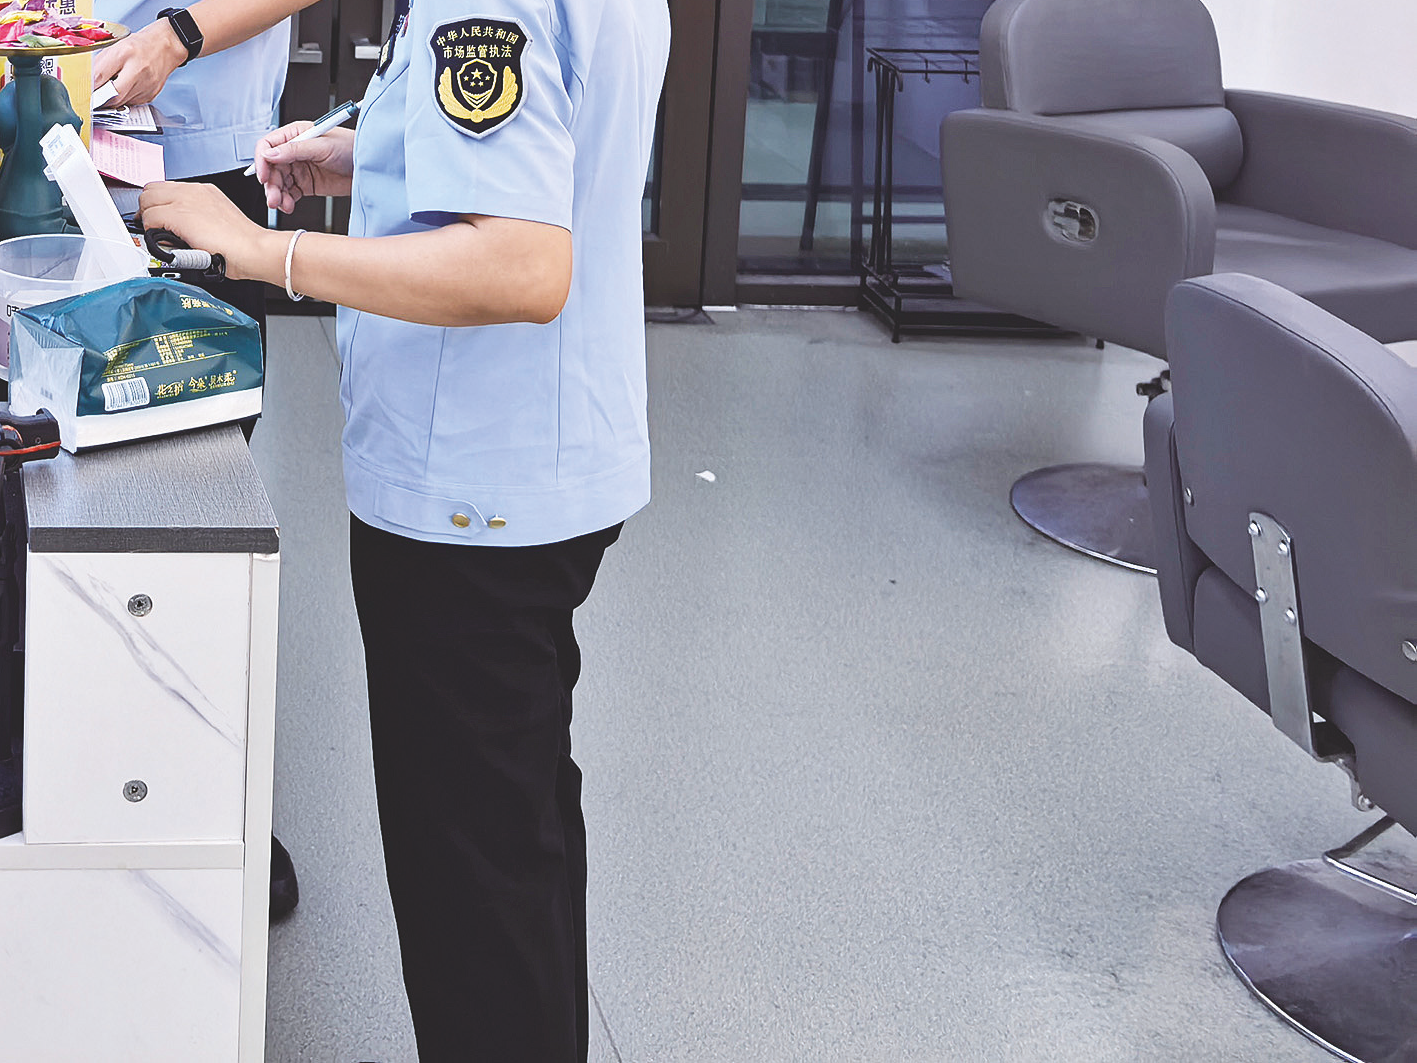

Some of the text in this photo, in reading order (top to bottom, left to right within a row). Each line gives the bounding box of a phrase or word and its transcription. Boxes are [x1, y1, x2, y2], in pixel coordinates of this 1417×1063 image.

[436, 25, 520, 47] 中华人民共和国
[442, 44, 513, 59] 市场监管执法
